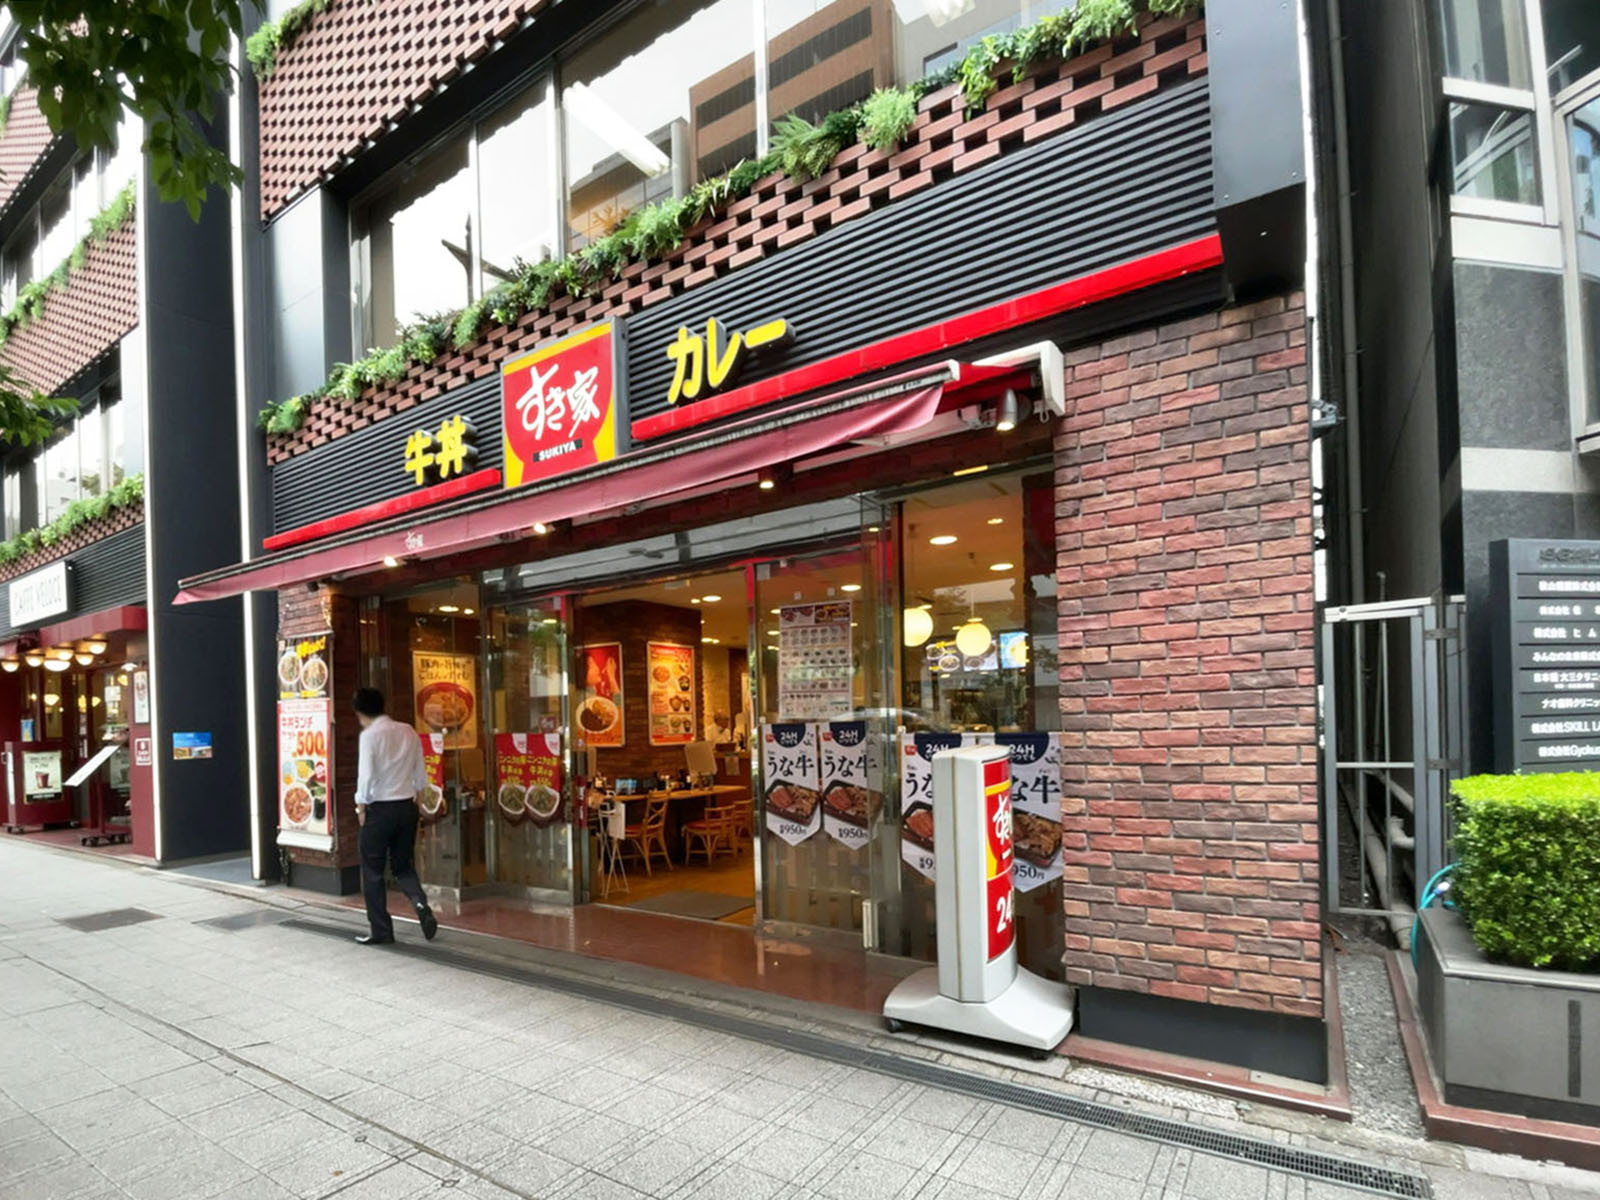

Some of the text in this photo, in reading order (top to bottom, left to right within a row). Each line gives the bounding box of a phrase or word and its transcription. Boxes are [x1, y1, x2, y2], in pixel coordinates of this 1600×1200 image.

[666, 317, 787, 405] カレー
[515, 363, 601, 441] すき家
[405, 415, 467, 486] 牛丼
[538, 441, 577, 461] SUKIYA
[767, 754, 815, 779] うな牛
[824, 754, 878, 779] うな牛
